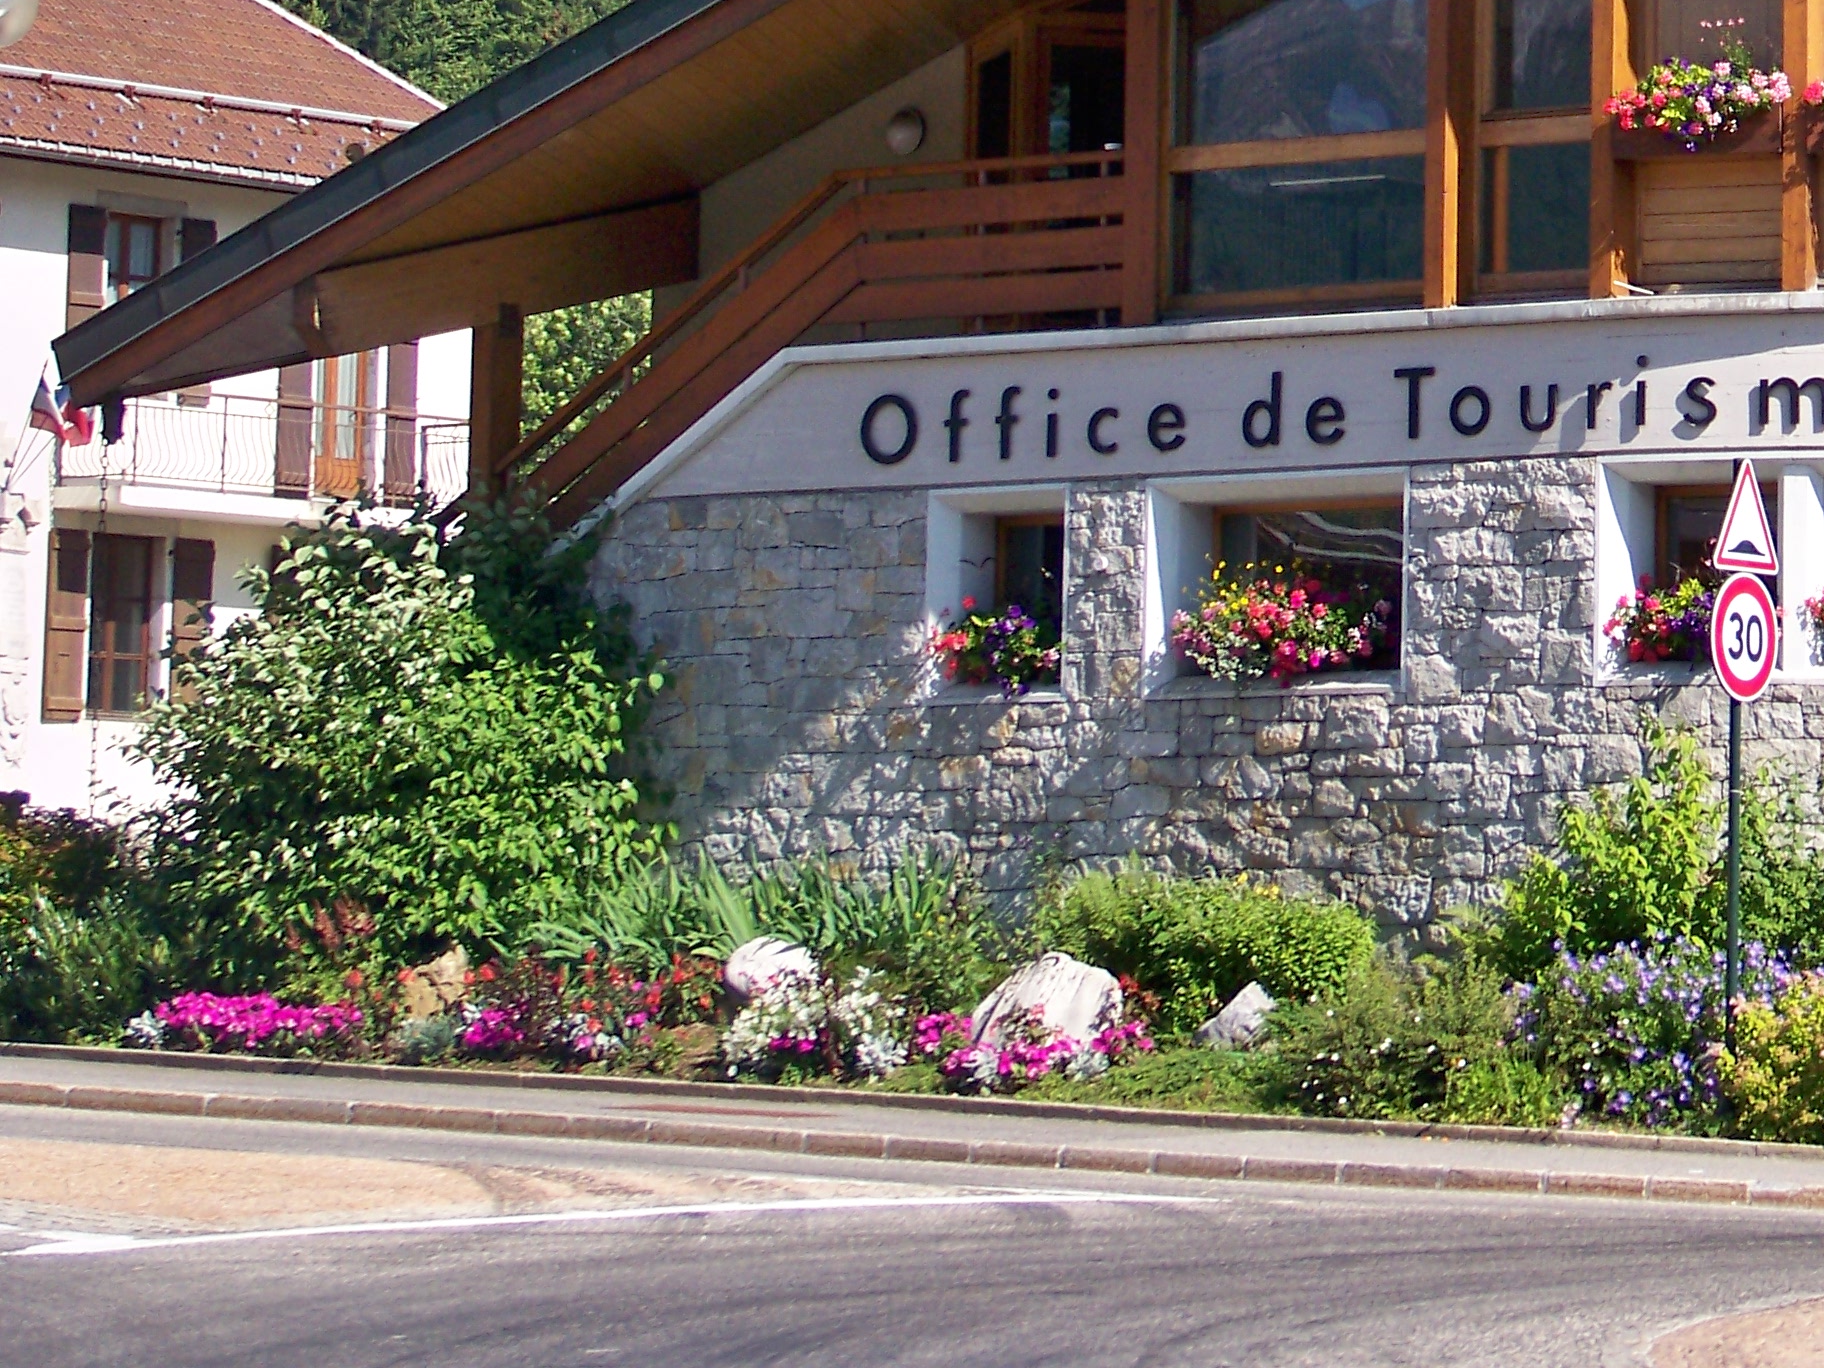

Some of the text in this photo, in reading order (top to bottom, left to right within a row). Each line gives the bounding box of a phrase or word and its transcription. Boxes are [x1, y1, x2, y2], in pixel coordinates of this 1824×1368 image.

[858, 384, 1188, 468] Office
[1241, 370, 1347, 451] de
[1727, 612, 1763, 663] 30
